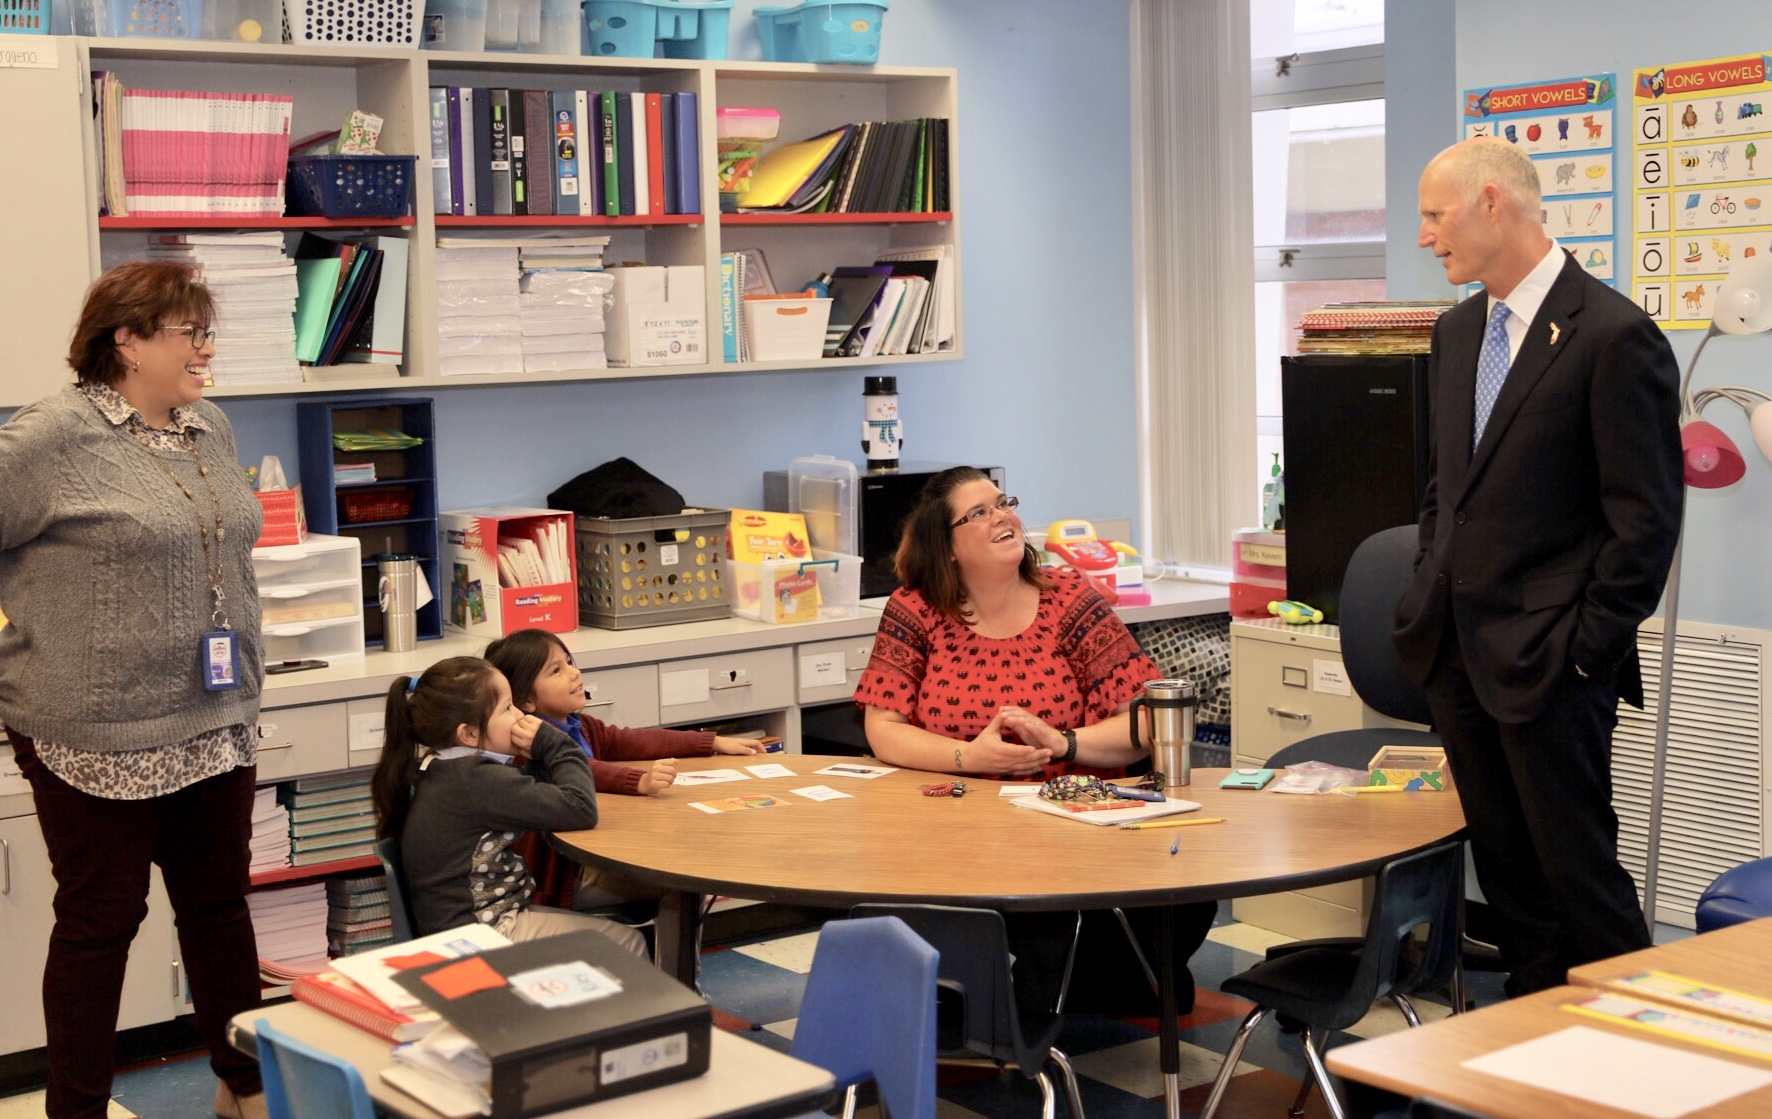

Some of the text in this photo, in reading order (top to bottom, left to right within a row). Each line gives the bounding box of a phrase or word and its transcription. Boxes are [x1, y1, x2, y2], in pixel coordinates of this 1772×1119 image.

[1666, 65, 1763, 89] LONG VOWELS
[1491, 87, 1586, 109] SHORT VOWELS
[721, 263, 733, 336] Dictionary
[749, 536, 783, 546] Your Turn
[779, 578, 814, 588] Photo Cards
[515, 597, 539, 606] Reading
[539, 594, 562, 603] Mastery
